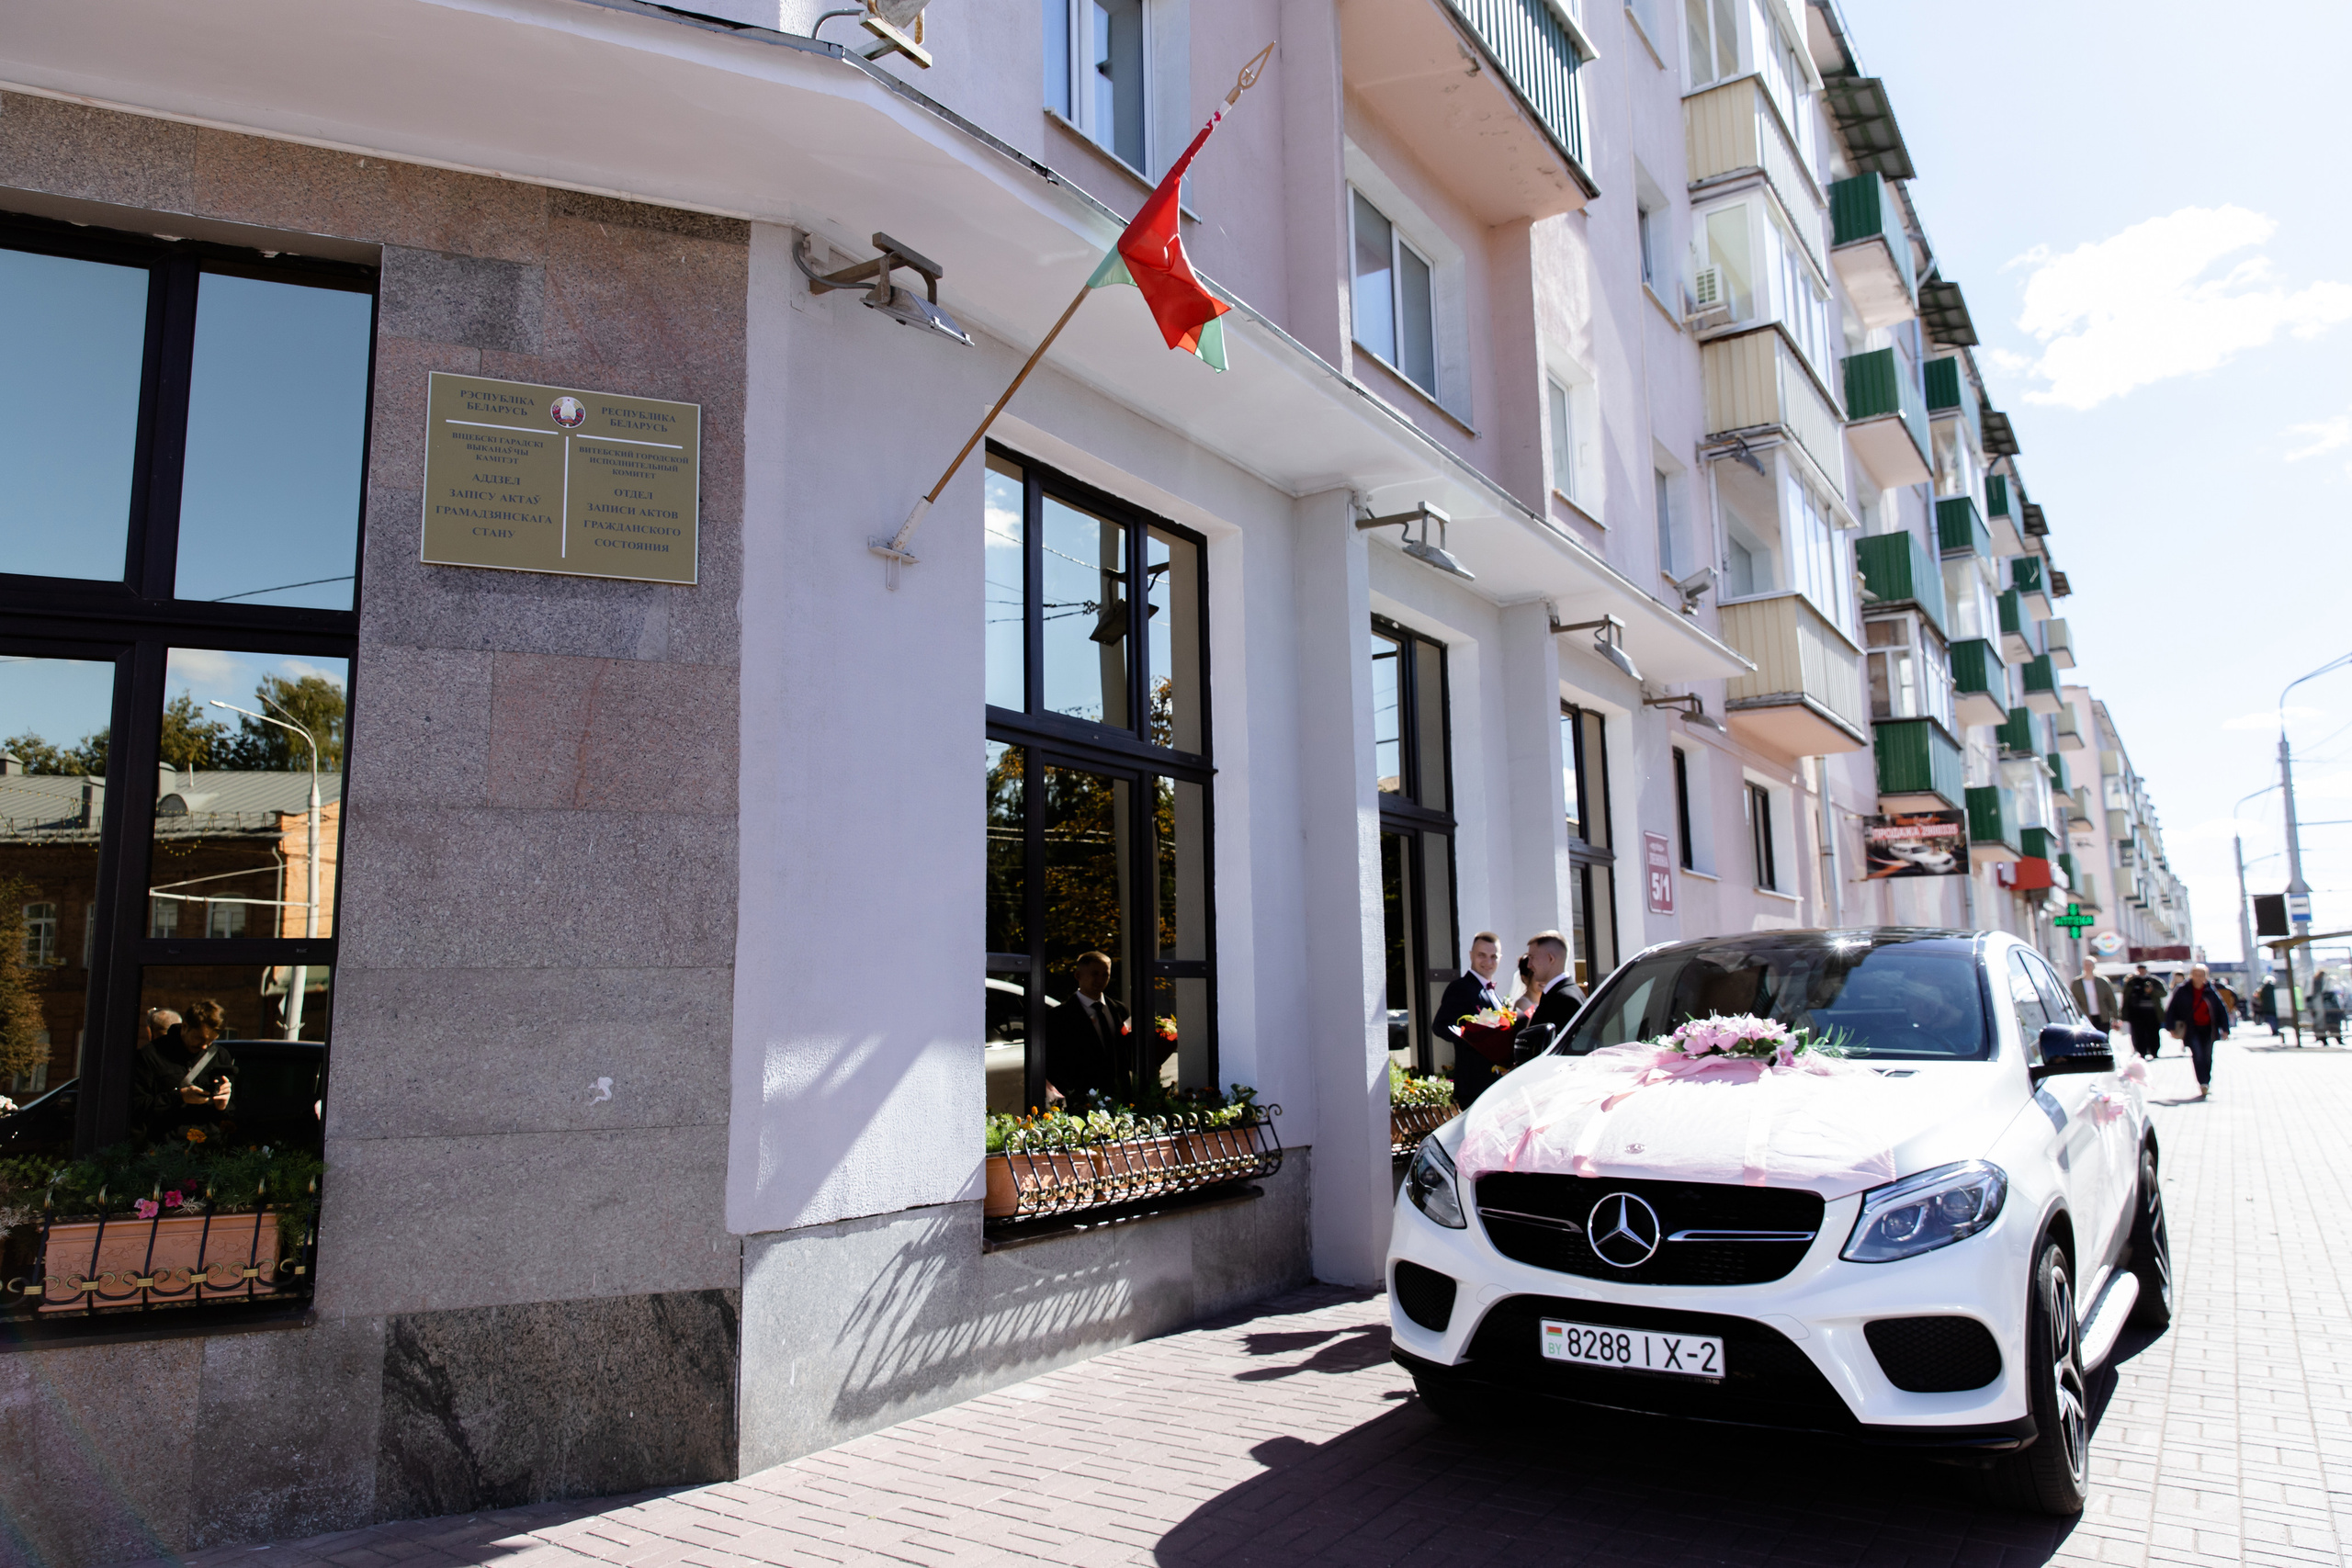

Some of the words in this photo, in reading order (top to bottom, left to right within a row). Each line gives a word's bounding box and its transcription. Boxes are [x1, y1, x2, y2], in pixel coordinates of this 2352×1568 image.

[460, 389, 535, 406] РЭСПУБЛІКА
[467, 401, 527, 416] БЕЛАРУСЬ
[602, 406, 676, 423] РЕСПУБЛИКА
[610, 418, 668, 432] БЕЛАРУСЬ
[452, 432, 497, 443] ВІЦЕБСКІ
[499, 437, 544, 448] ГАРАДСКІ
[467, 444, 529, 456] ВЫКАНАЎЧЫ
[579, 446, 634, 458] ВИТЕБСКИЙ
[636, 452, 689, 464] ГОРОДСКОЙ
[476, 454, 519, 464] КАМІТЭТ
[589, 457, 678, 472] ИСПОЛНИТЕЛЬНЫЙ
[471, 473, 521, 486] АДДЗЕЛ
[612, 468, 656, 479] КОМИТЕТ
[449, 489, 496, 501] ЗАПІСУ
[499, 494, 541, 505] АКТАЎ
[614, 488, 653, 500] ОТДЕЛ
[435, 505, 553, 525] ГРАМАДЗЯНСКАГА
[587, 502, 636, 514] ЗАПИСИ
[639, 508, 679, 519] АКТОВ
[471, 526, 515, 538] СТАНУ
[583, 519, 682, 536] ГРАЖДАНСКОГО
[594, 537, 670, 552] СОСТОЯНИЯ
[1872, 827, 1920, 840] ПРОДАЖА
[1651, 872, 1671, 903] 5/1
[2053, 915, 2094, 926] АПТЕКА
[1548, 1342, 1562, 1355] BY
[1567, 1327, 1631, 1363] 8288
